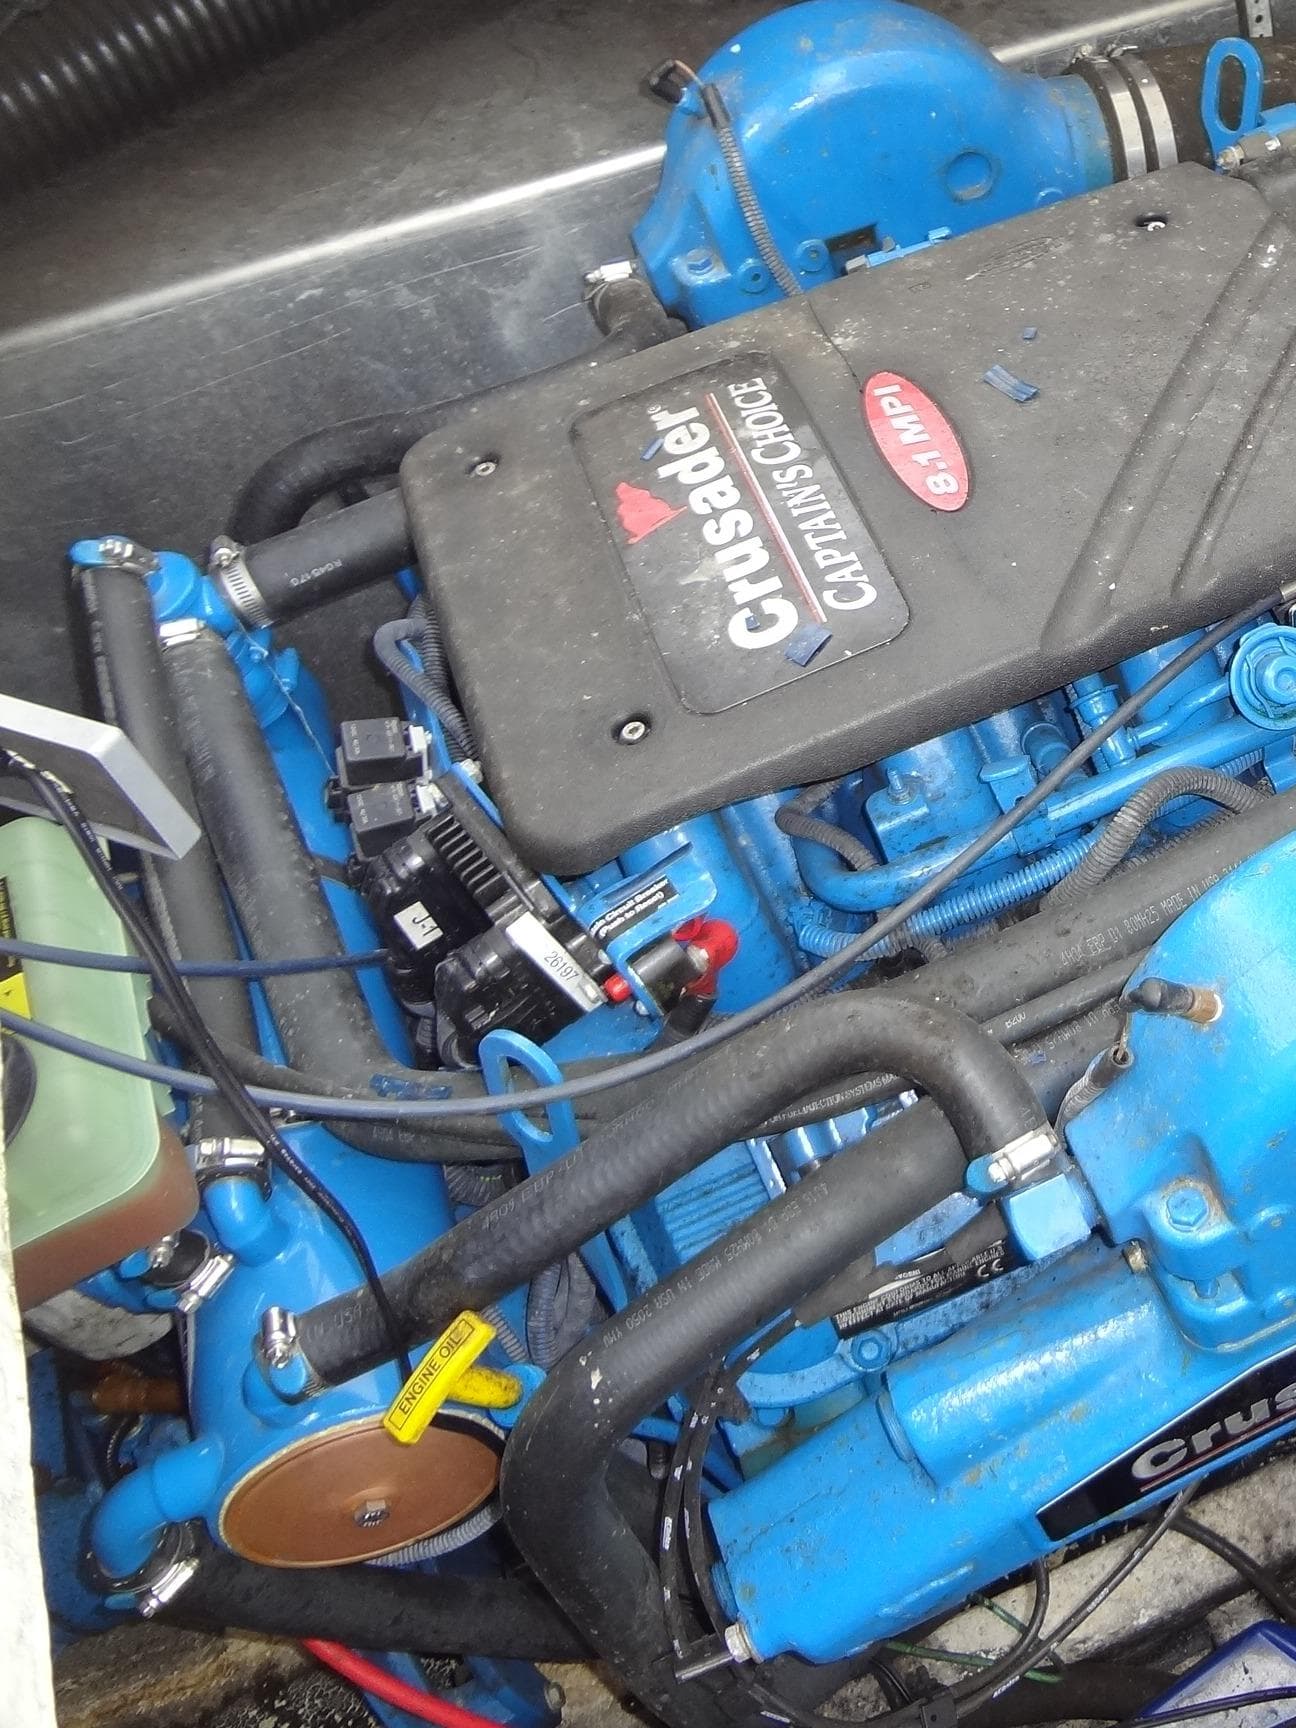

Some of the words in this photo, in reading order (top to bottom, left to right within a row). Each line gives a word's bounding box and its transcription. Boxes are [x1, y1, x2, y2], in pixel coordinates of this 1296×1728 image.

[727, 377, 803, 466] CHOICE
[873, 383, 936, 446] MPI
[911, 449, 960, 497] 8.1
[653, 404, 799, 650] Crusader
[776, 462, 879, 611] CAPTAIN'S
[604, 899, 636, 922] Circuit
[633, 878, 669, 903] Breaker
[543, 951, 580, 982] 26197
[398, 1358, 441, 1416] ENGINE
[438, 1336, 463, 1359] OIL
